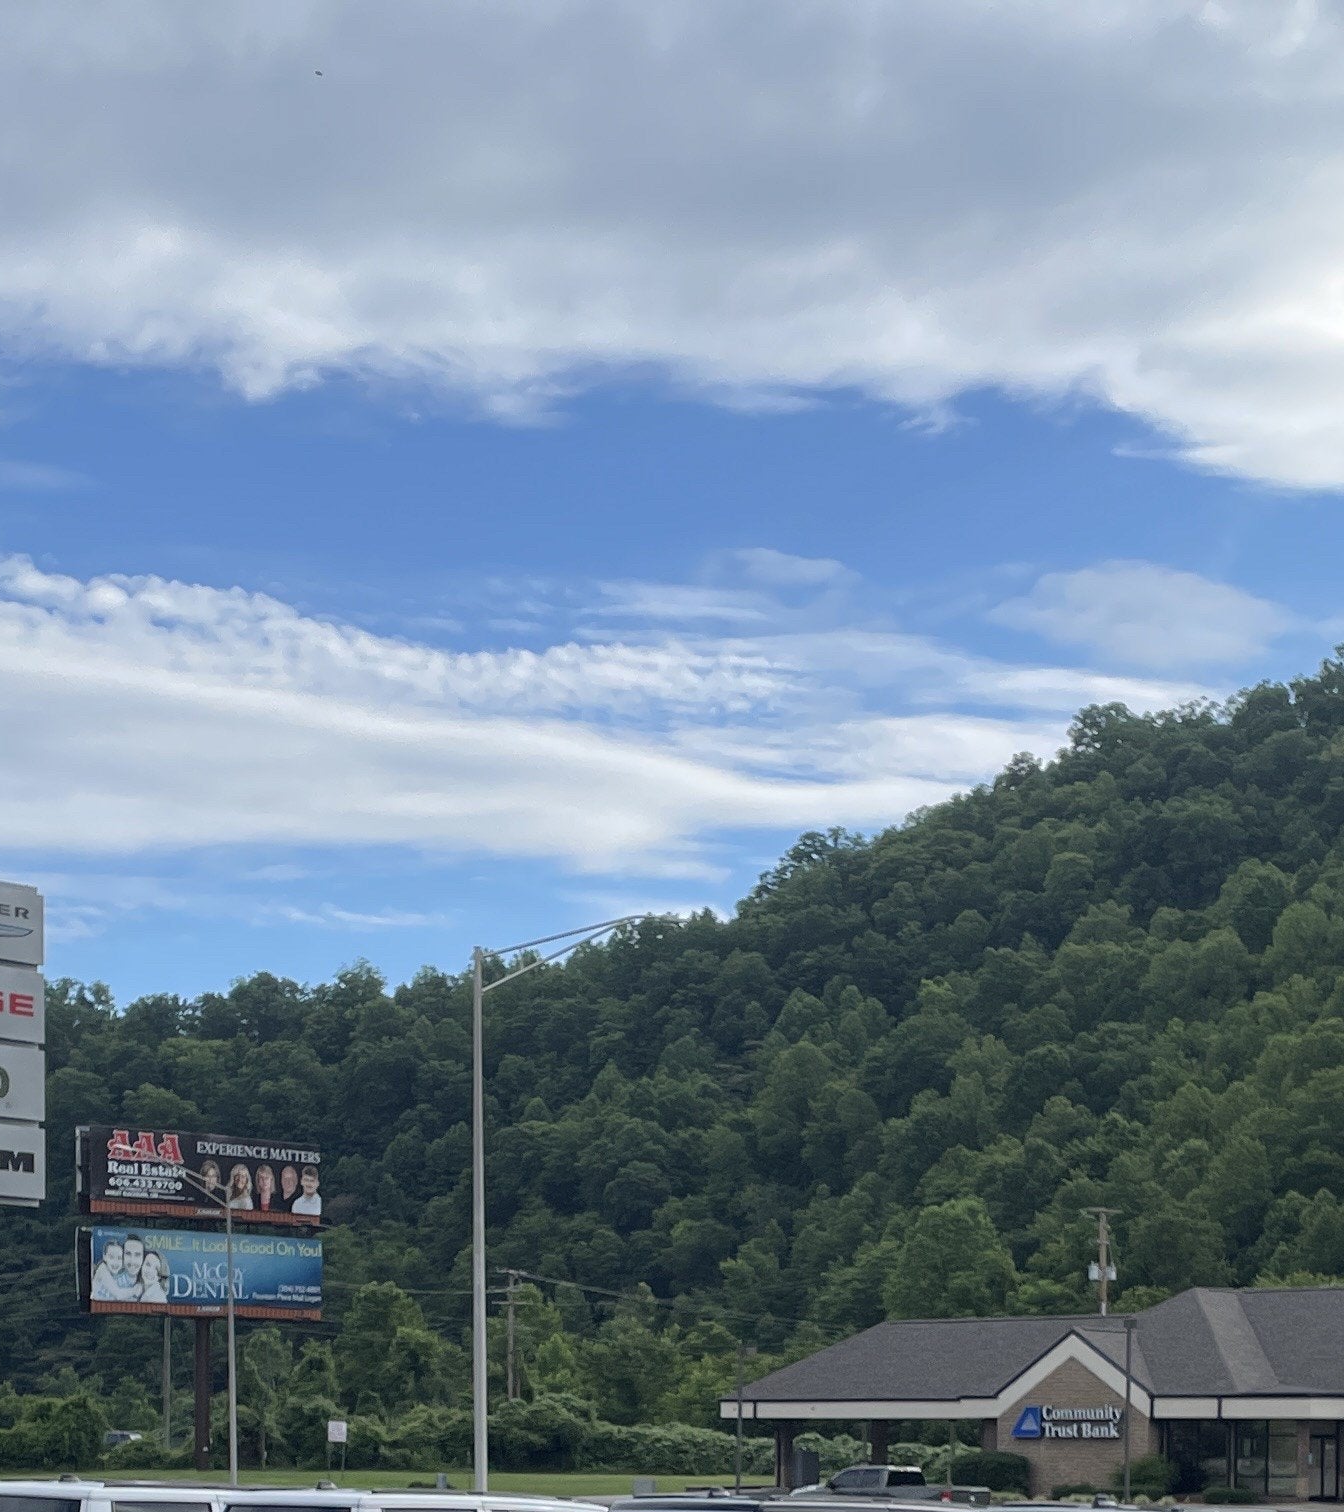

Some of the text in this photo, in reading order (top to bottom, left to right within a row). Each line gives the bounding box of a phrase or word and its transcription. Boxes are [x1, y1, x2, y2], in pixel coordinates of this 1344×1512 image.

[107, 1129, 184, 1165] AAA
[196, 1141, 321, 1163] EXPERIENCE MATTERS
[107, 1160, 138, 1174] Real
[239, 1240, 274, 1255] Good
[276, 1241, 295, 1256] On
[1042, 1403, 1122, 1424] Community
[1042, 1421, 1120, 1438] Trust Bank
